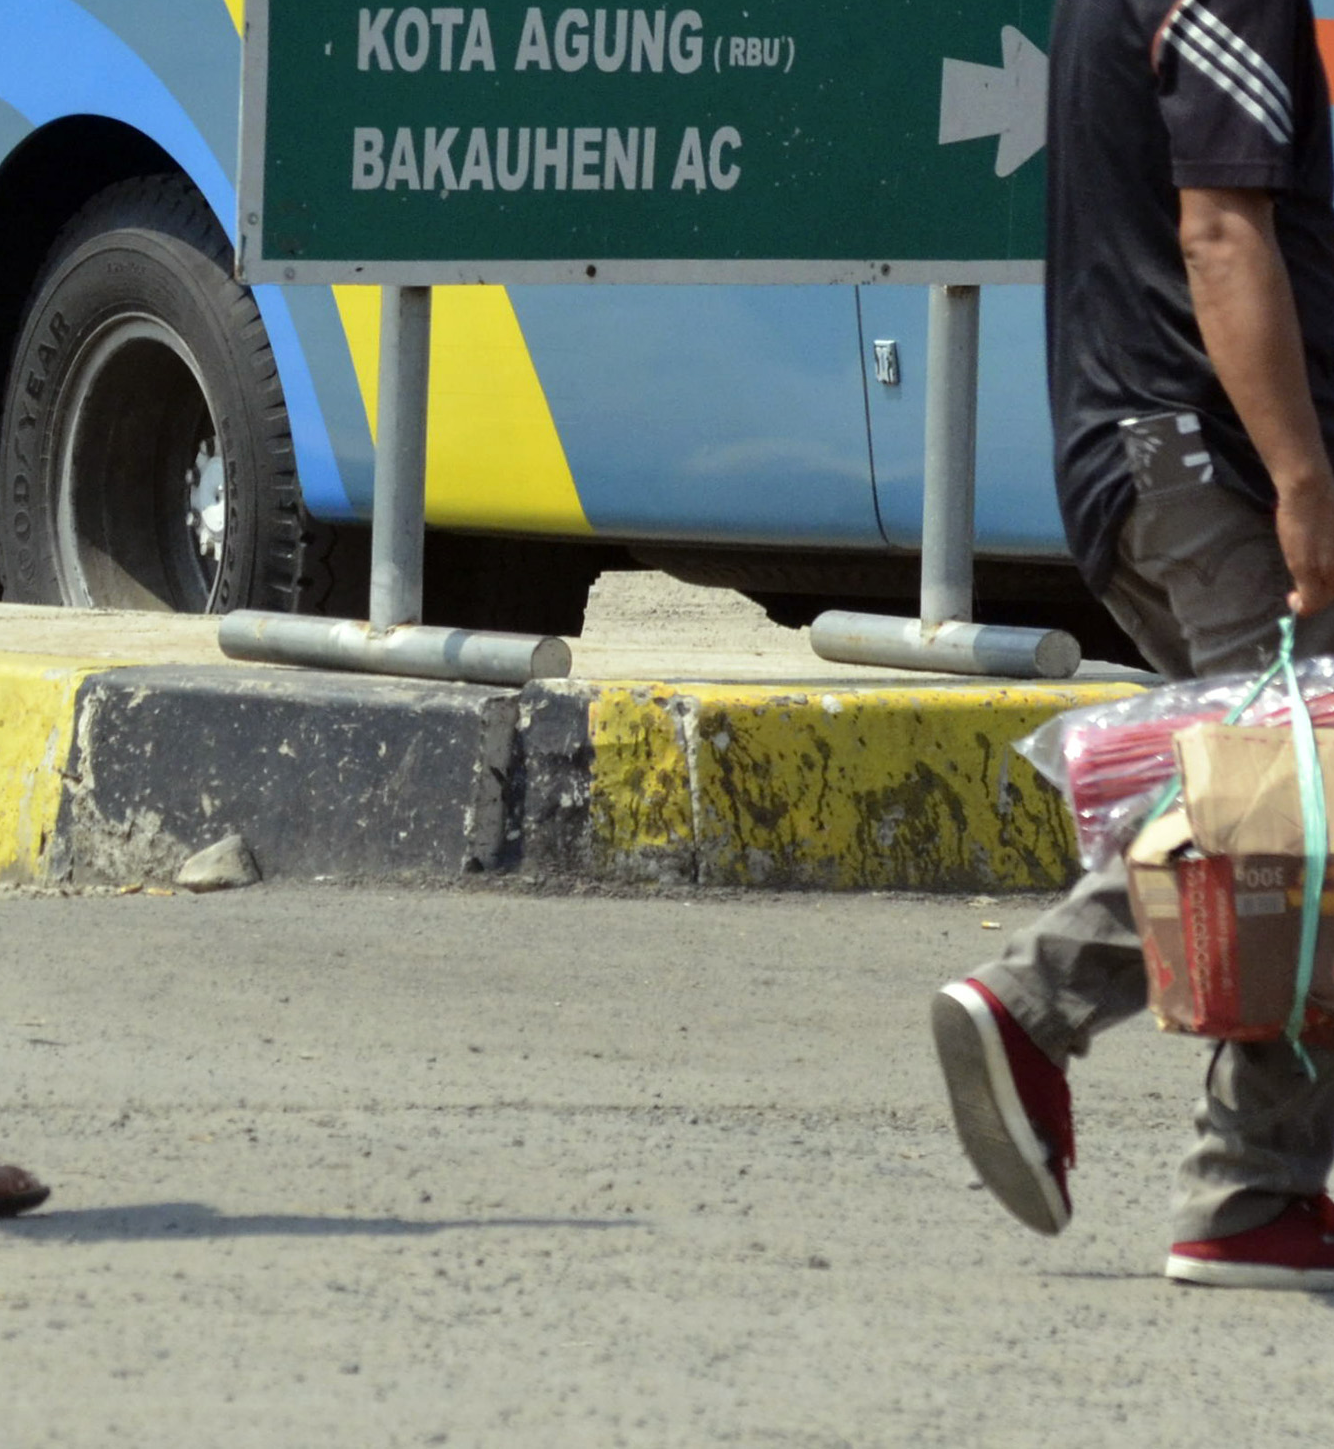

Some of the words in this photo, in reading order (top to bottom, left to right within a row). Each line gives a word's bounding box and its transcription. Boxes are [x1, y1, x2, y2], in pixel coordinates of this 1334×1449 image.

[357, 7, 496, 72] KOTA
[514, 7, 703, 74] AGUNG
[351, 126, 656, 191] BAKAUHENI
[671, 125, 743, 193] AC
